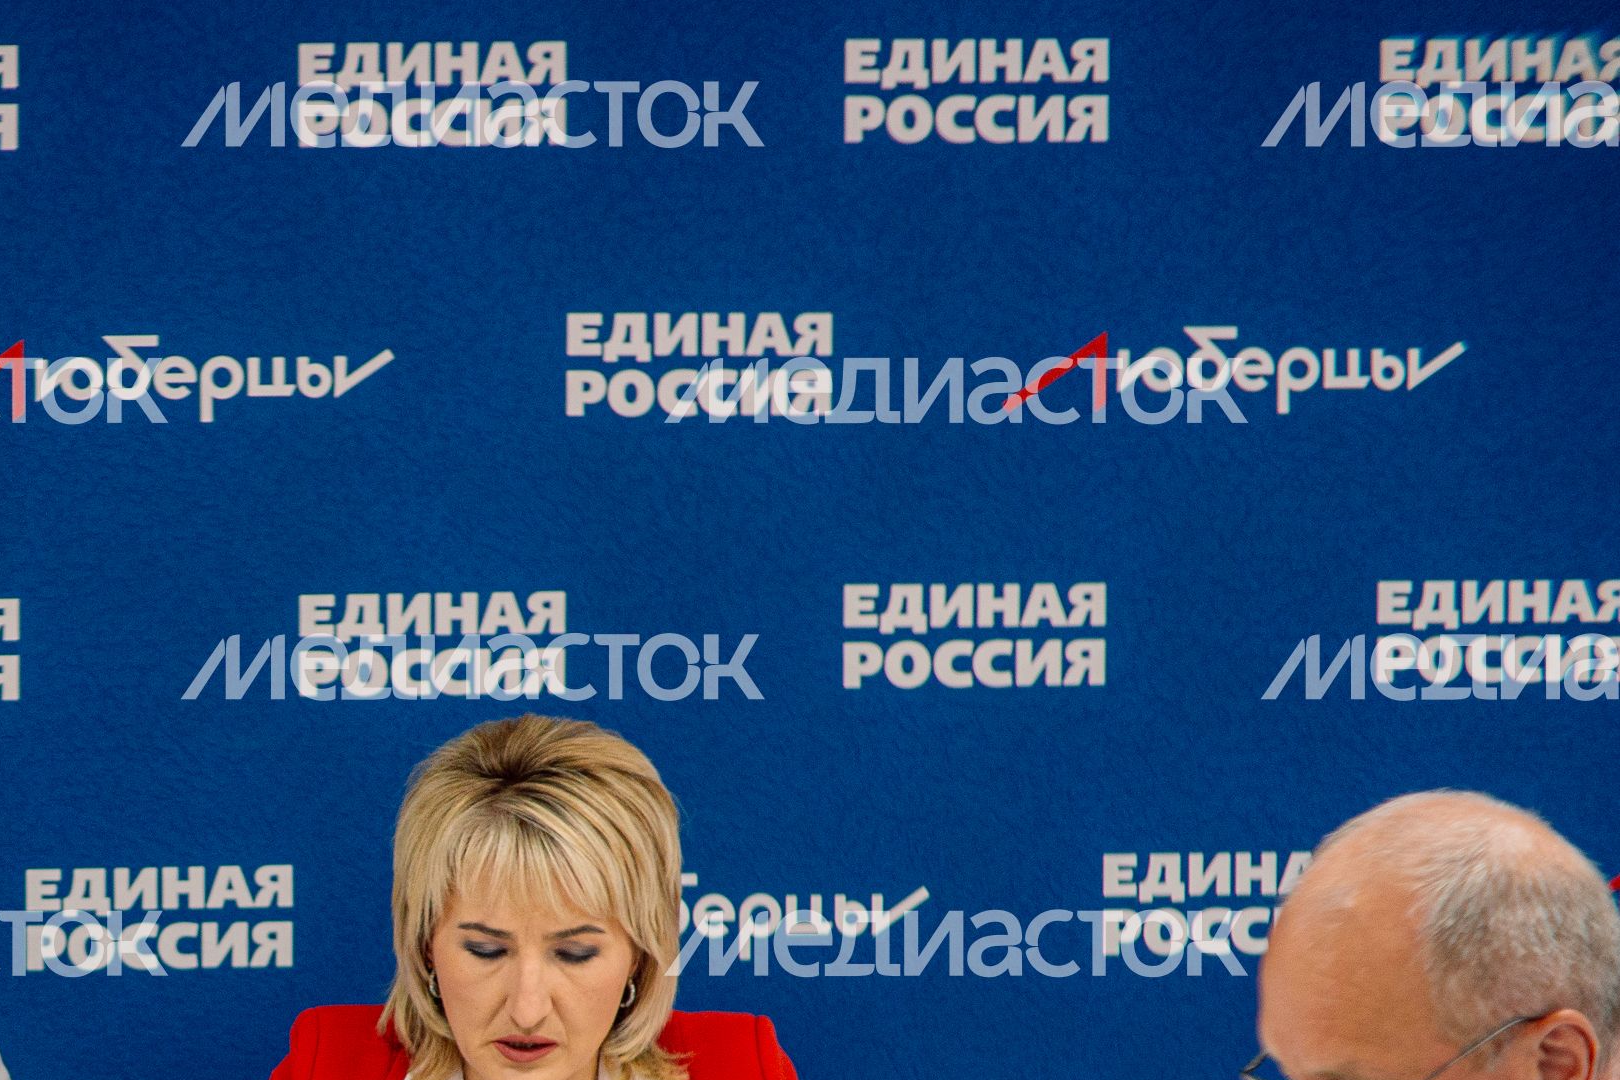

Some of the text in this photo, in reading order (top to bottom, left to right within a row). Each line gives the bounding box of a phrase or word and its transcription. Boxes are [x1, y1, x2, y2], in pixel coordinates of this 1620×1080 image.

[297, 41, 568, 90] ЕДИНАЯ
[843, 38, 1111, 90] ЕДИНАЯ
[297, 97, 568, 148] РОССИЯ
[843, 94, 1111, 143] РОССИЯ
[565, 312, 834, 362] ЕДИНАЯ
[565, 368, 834, 418] РОССИЯ
[1002, 326, 1468, 415] Люберцы
[297, 590, 567, 640] ЕДИНАЯ
[842, 582, 1107, 634] ЕДИНАЯ
[297, 646, 567, 697] РОССИЯ
[842, 638, 1107, 689] РОССИЯ
[25, 864, 293, 916] ЕДИНАЯ
[25, 920, 293, 971] РОССИЯ
